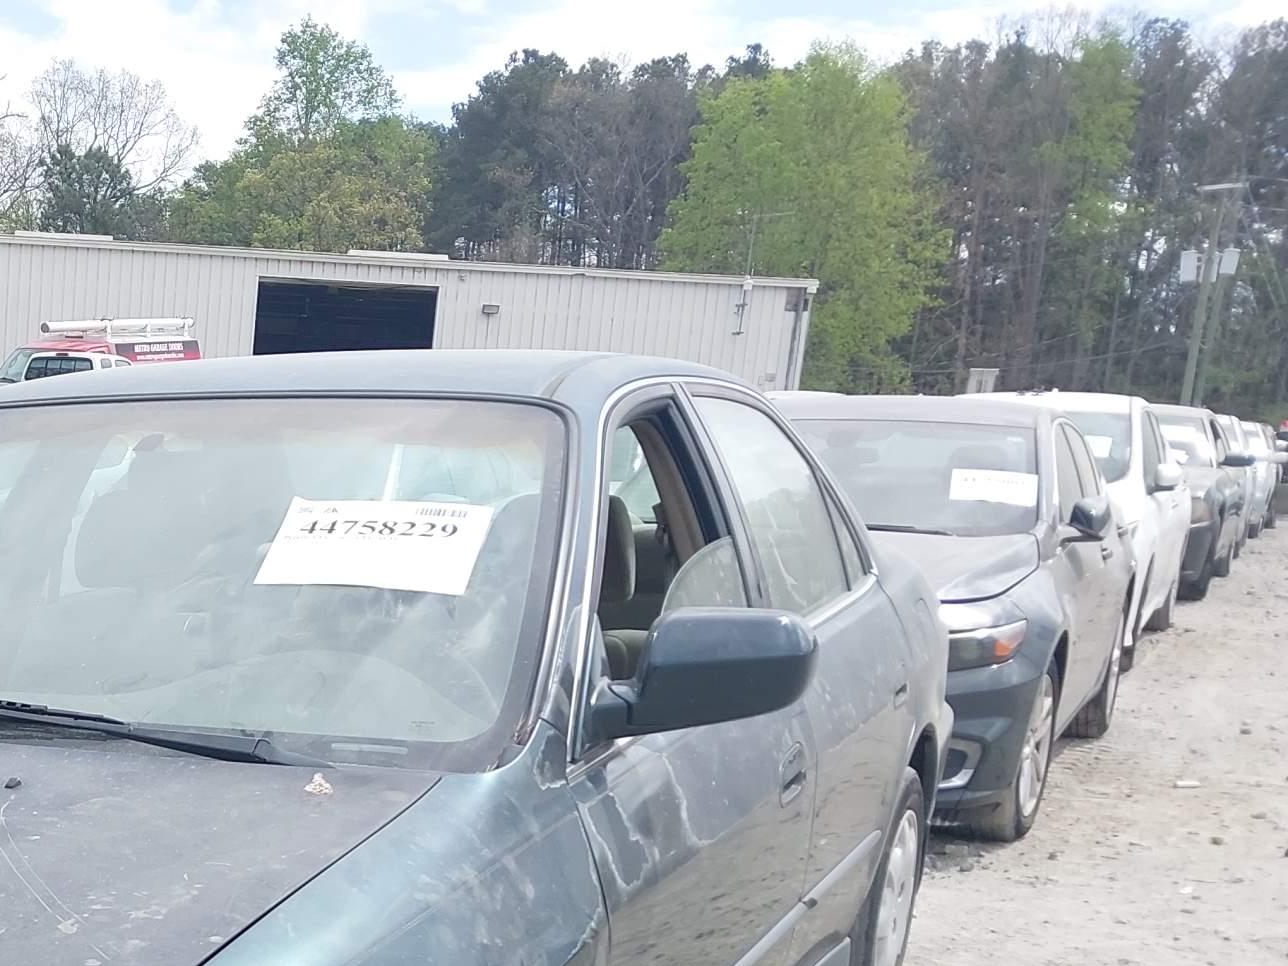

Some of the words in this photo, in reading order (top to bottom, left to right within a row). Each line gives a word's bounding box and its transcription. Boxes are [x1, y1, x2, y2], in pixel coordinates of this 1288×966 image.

[151, 343, 168, 352] GARAGE
[168, 342, 184, 351] DOORS
[299, 519, 459, 538] 44758229
